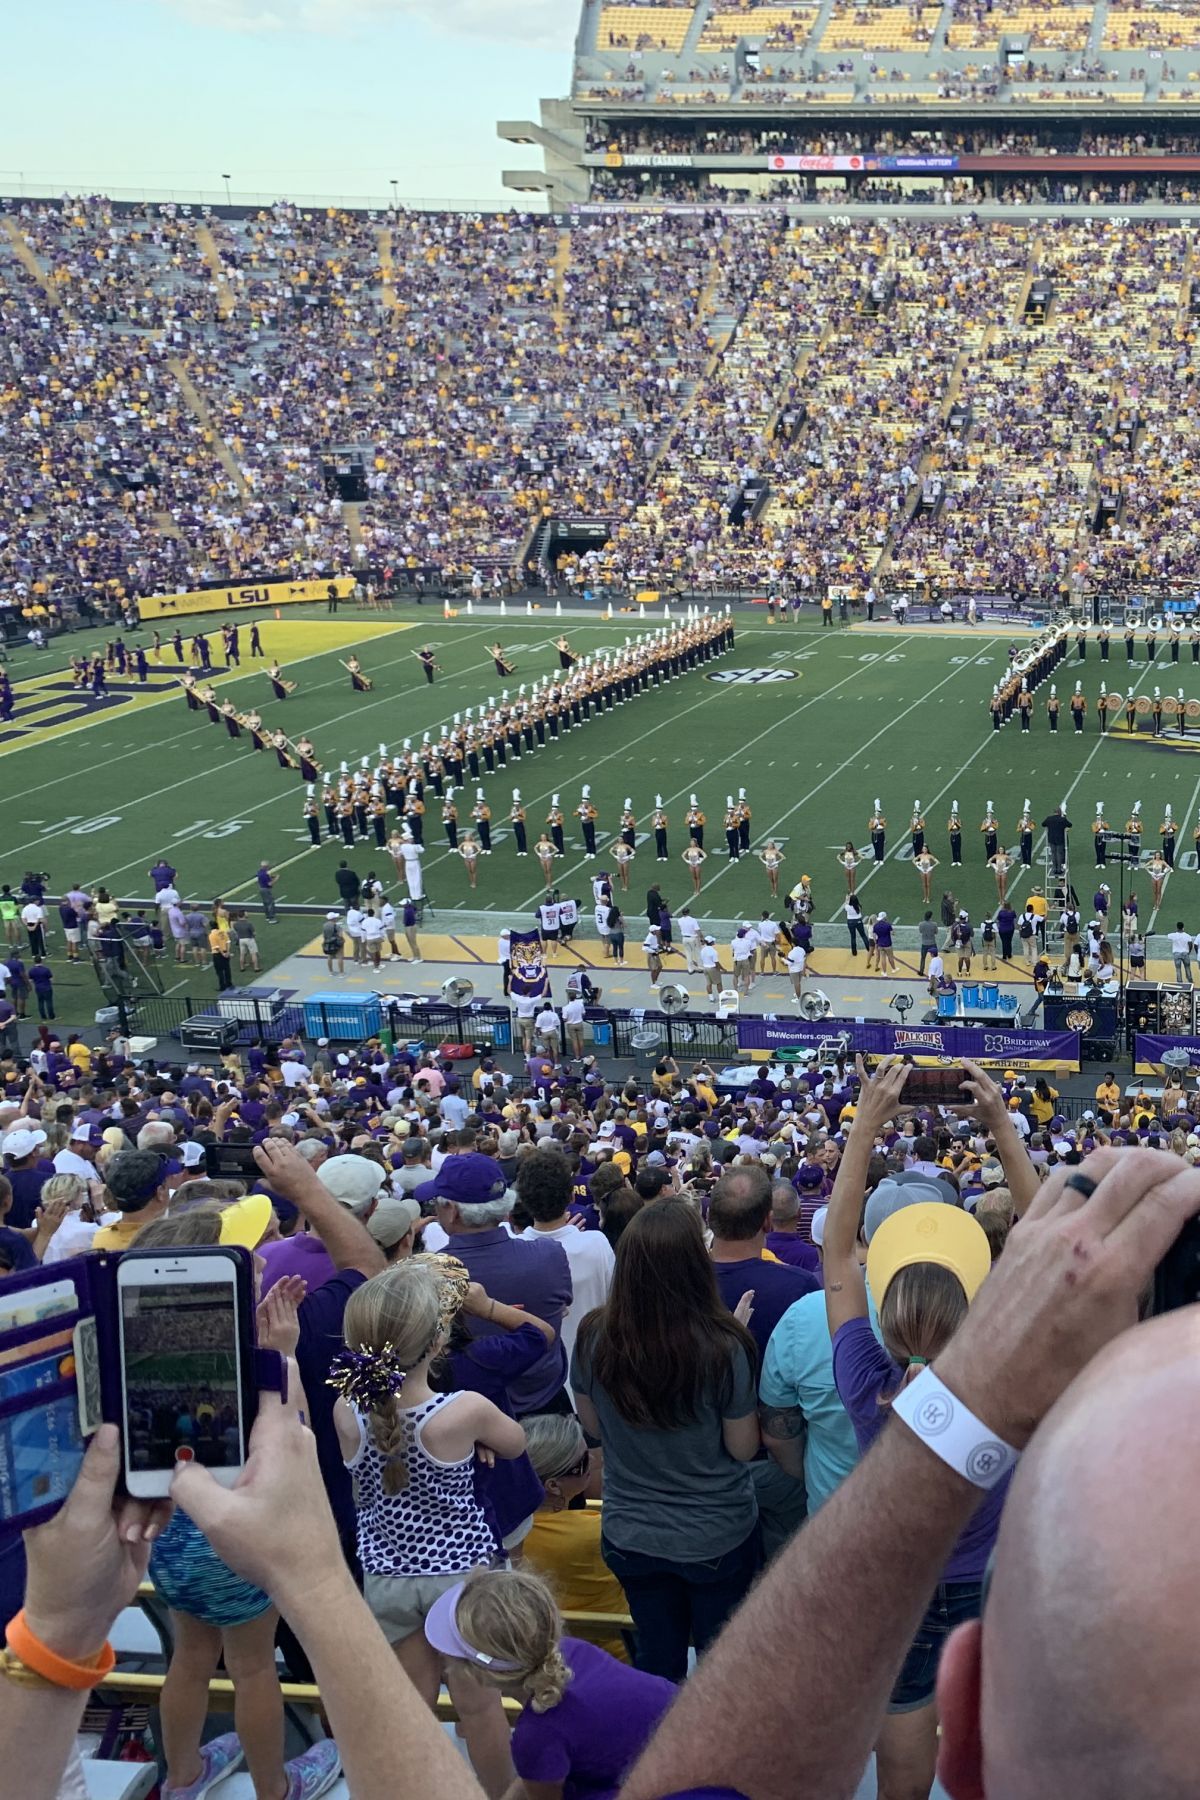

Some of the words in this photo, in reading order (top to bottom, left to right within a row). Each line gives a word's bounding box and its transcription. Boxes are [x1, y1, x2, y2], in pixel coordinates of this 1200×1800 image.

[227, 588, 270, 606] LSU
[709, 668, 796, 684] SEC
[39, 815, 123, 834] 10
[171, 819, 254, 838] 15
[766, 1031, 833, 1040] BMWcenters.com
[1003, 1036, 1050, 1046] BRIDGEWAY
[987, 1060, 1031, 1068] PARTNER
